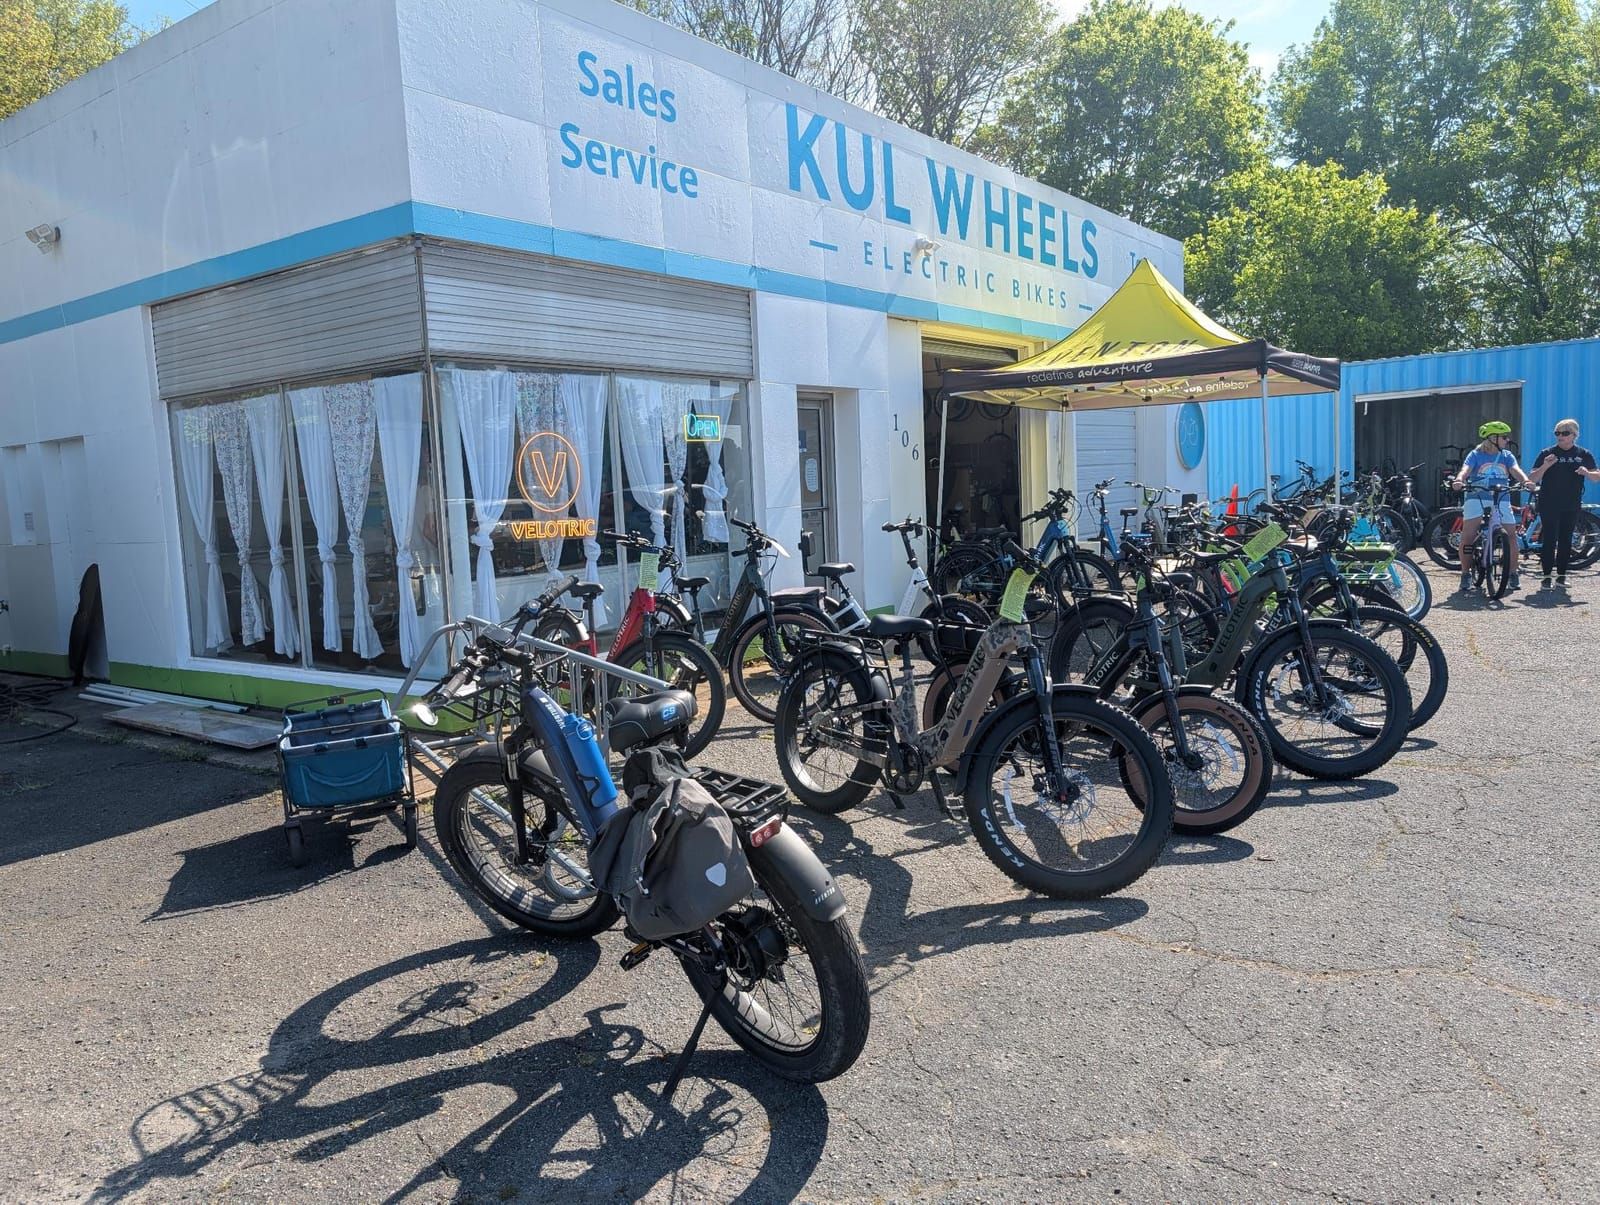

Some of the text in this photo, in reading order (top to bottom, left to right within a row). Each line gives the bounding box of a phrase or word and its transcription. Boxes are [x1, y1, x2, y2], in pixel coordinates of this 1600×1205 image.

[577, 50, 677, 123] Sales
[559, 122, 698, 199] Service
[785, 102, 1099, 279] KUL WHEELS
[864, 241, 1068, 309] ELECTRIC BIKES
[1026, 361, 1154, 384] redefine adventure
[893, 413, 920, 461] 106
[531, 451, 567, 498] V
[511, 518, 596, 542] VELOTRIC
[609, 615, 630, 657] VELOTRIC
[1216, 597, 1251, 655] VELOTRIC
[946, 645, 986, 721] VELOTRIC
[1089, 650, 1120, 687] ELOTRIC
[1255, 670, 1265, 721] KENDA
[1215, 706, 1258, 756] KENDA
[980, 807, 1025, 868] KENDA
